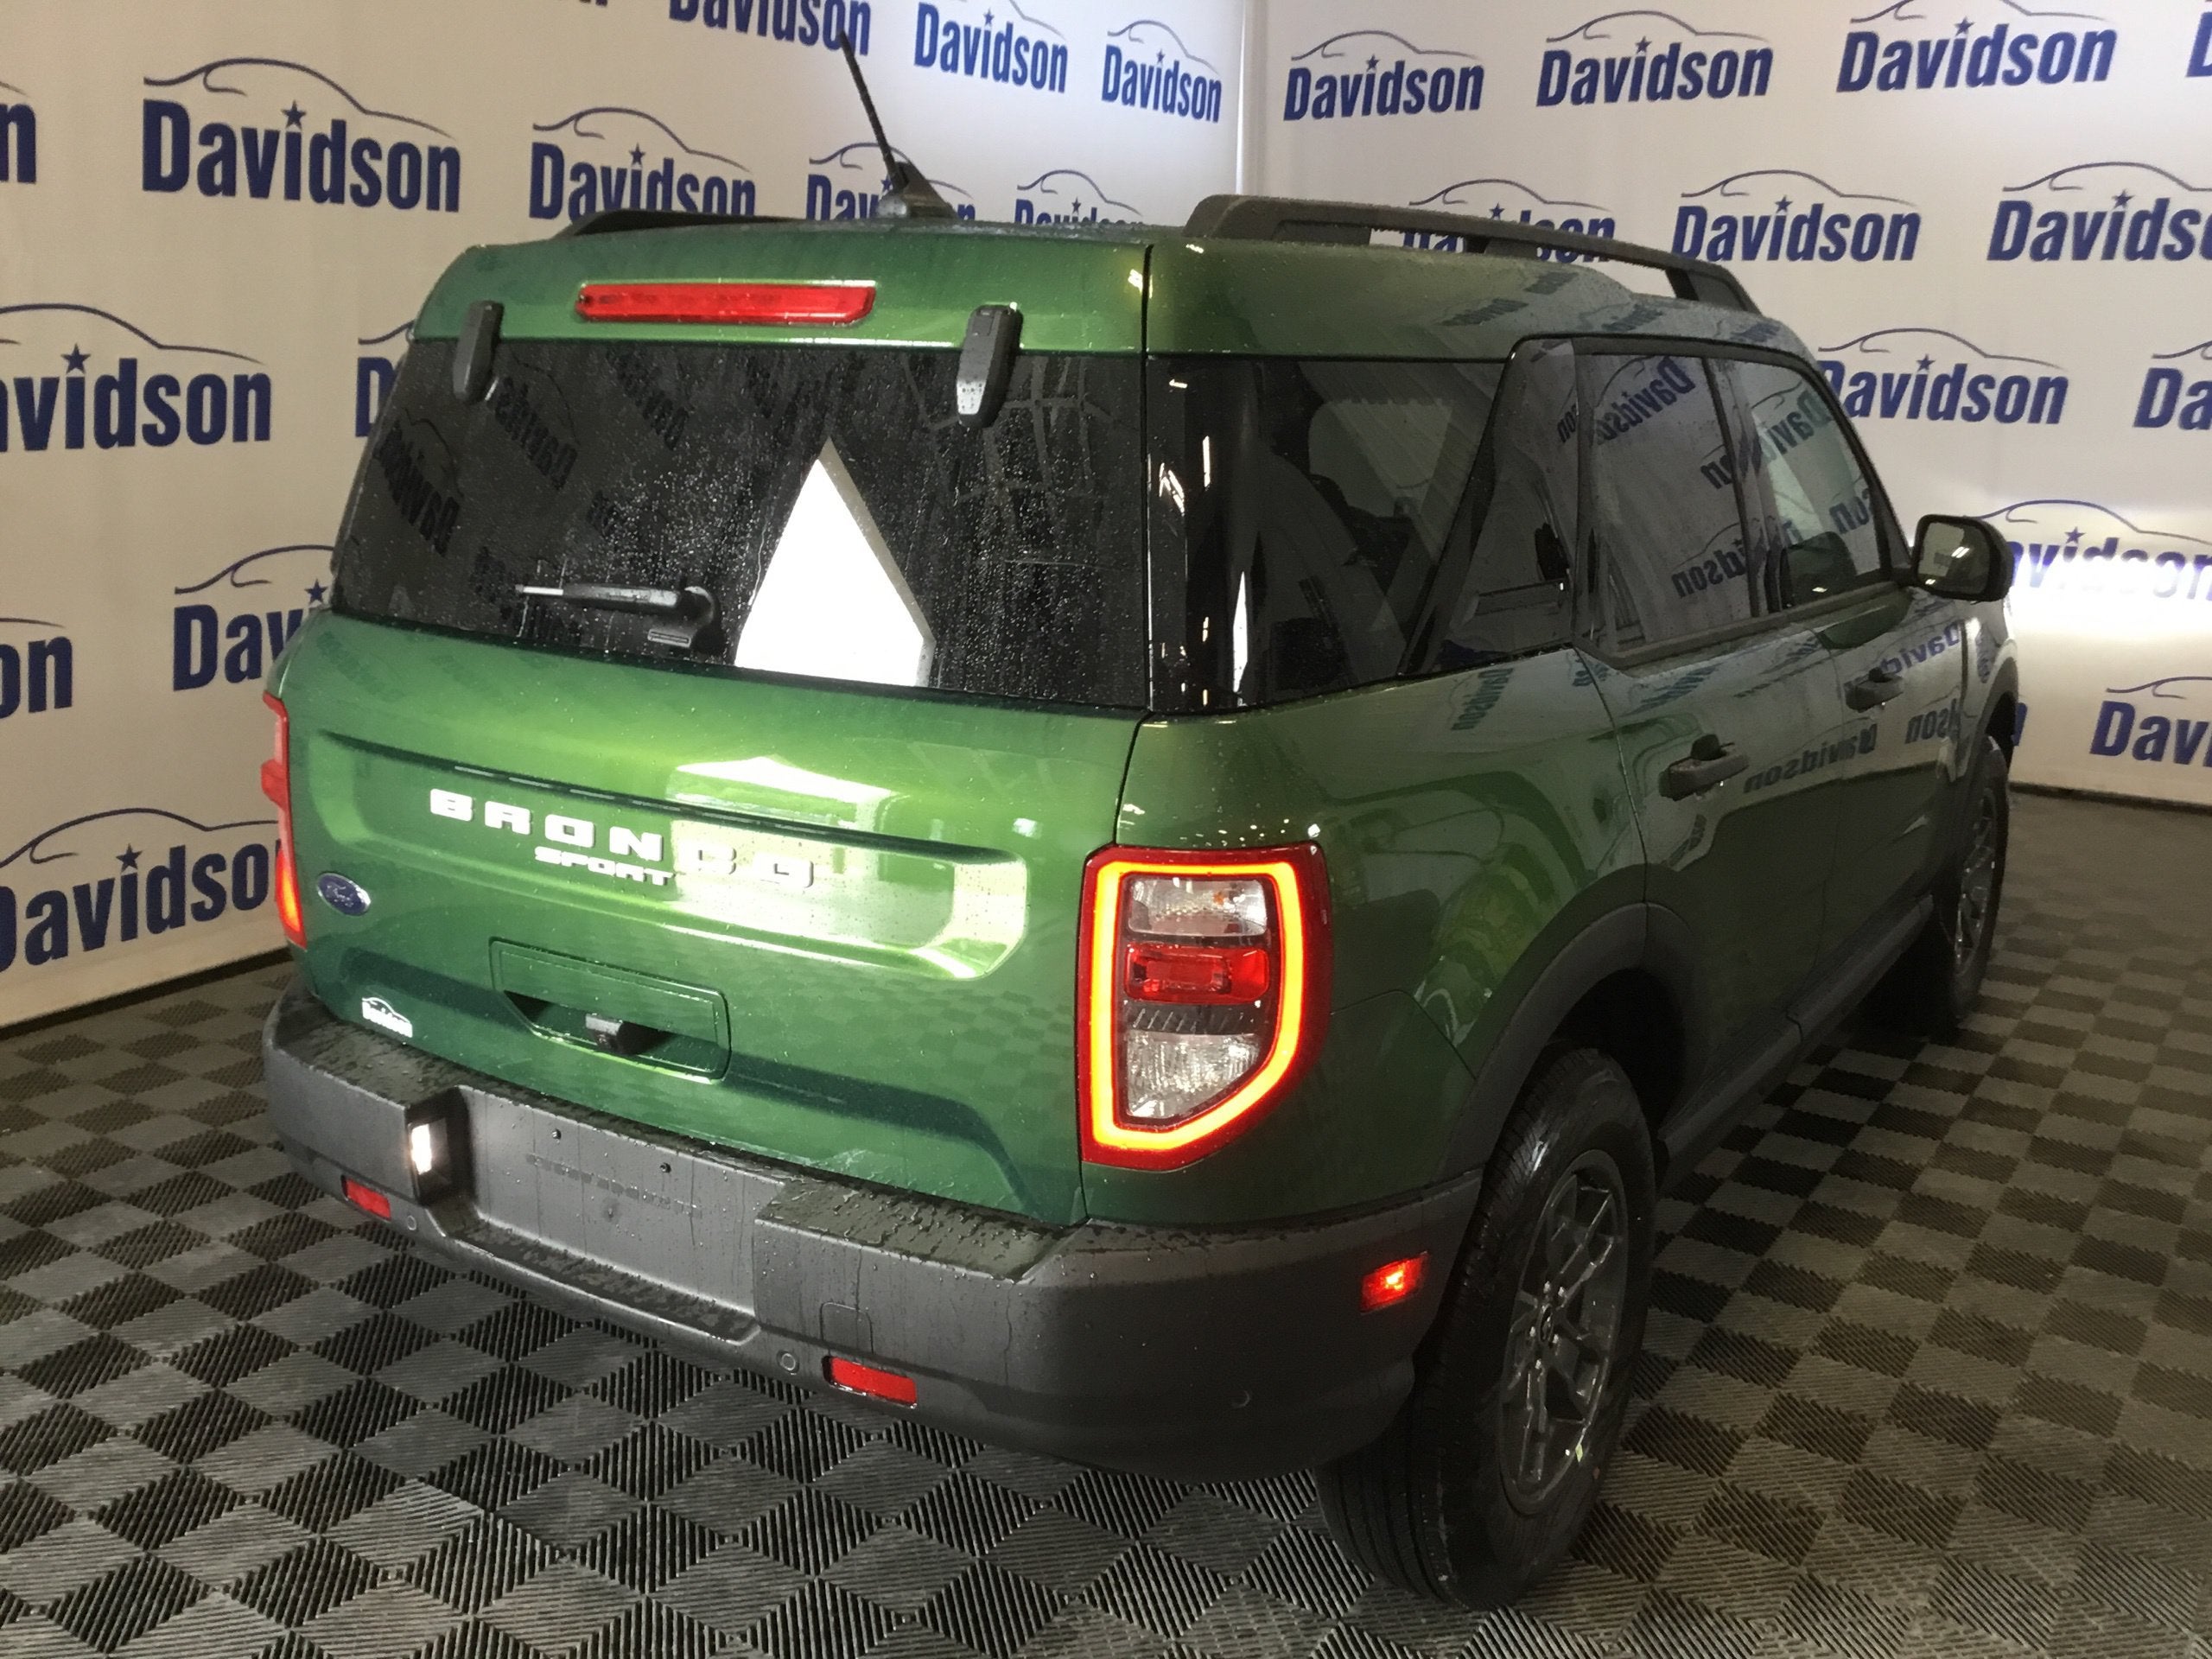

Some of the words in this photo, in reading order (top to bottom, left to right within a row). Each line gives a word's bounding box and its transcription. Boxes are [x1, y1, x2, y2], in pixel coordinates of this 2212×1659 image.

[913, 2, 1068, 93] Davidson
[1101, 44, 1223, 123] Davidson
[1536, 41, 1773, 107] Davidson
[1836, 23, 2117, 92] Davidson
[1283, 60, 1484, 121] Davidson
[143, 99, 461, 213] Davidson
[529, 142, 756, 223] Davidson
[1671, 202, 1922, 262] Davidson
[0, 357, 271, 453] vidson
[430, 788, 815, 888] BRONCO
[535, 846, 676, 887] SPORT
[0, 838, 281, 973] avidso
